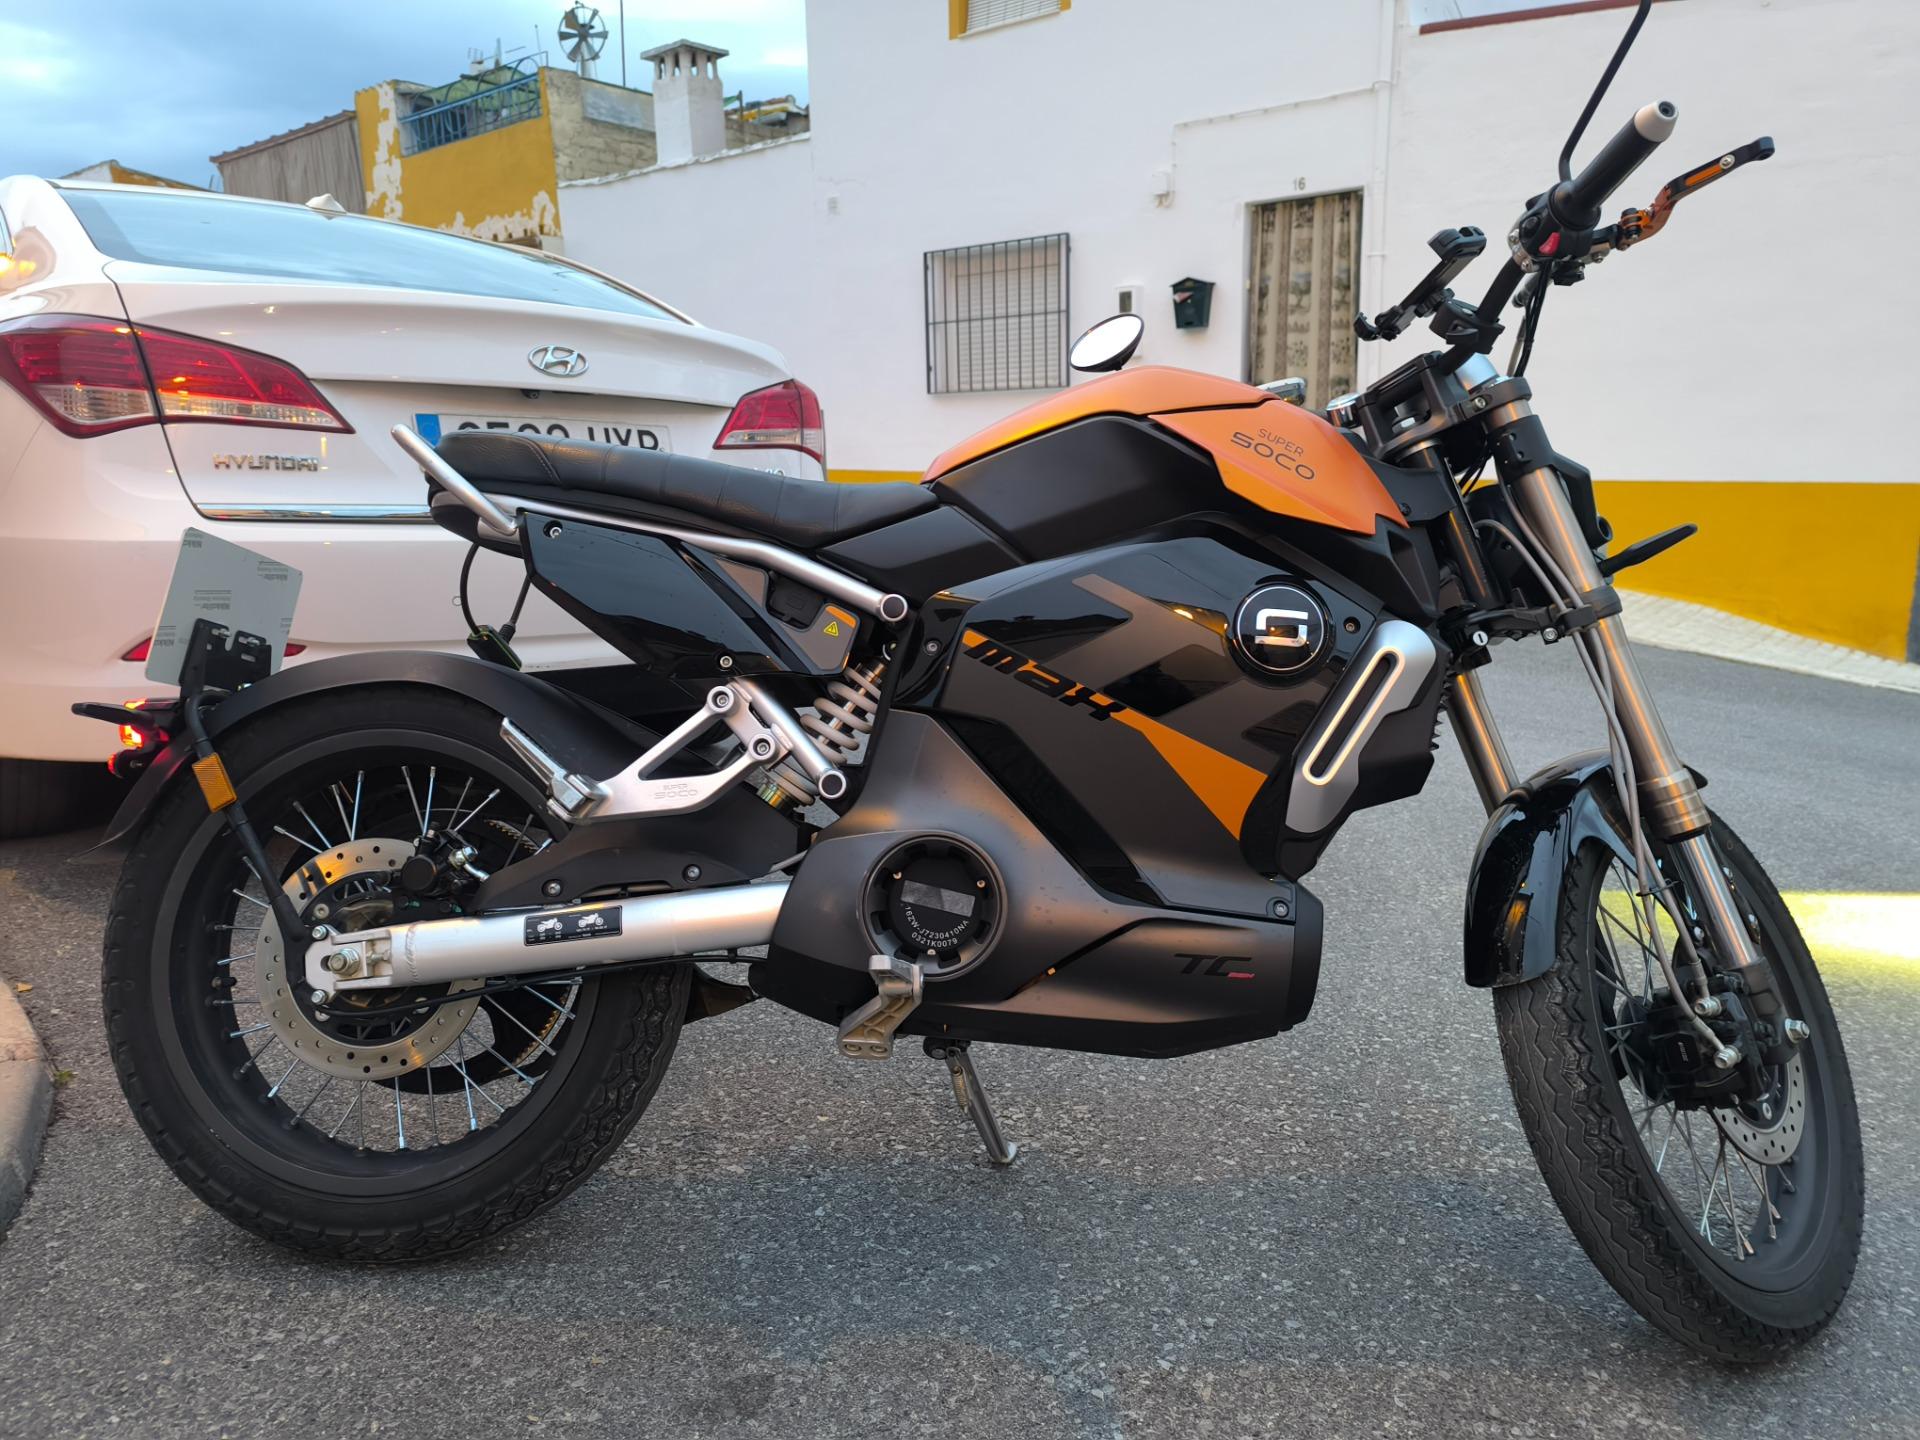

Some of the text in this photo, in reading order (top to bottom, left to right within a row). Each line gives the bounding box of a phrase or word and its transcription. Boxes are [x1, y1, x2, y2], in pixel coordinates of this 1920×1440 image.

[1293, 176, 1306, 191] 16
[1258, 428, 1304, 456] SUPER
[213, 454, 318, 471] HYUNDAI
[1230, 431, 1315, 480] SOCO
[655, 789, 698, 800] SOCO
[911, 931, 958, 947] 0321K0079
